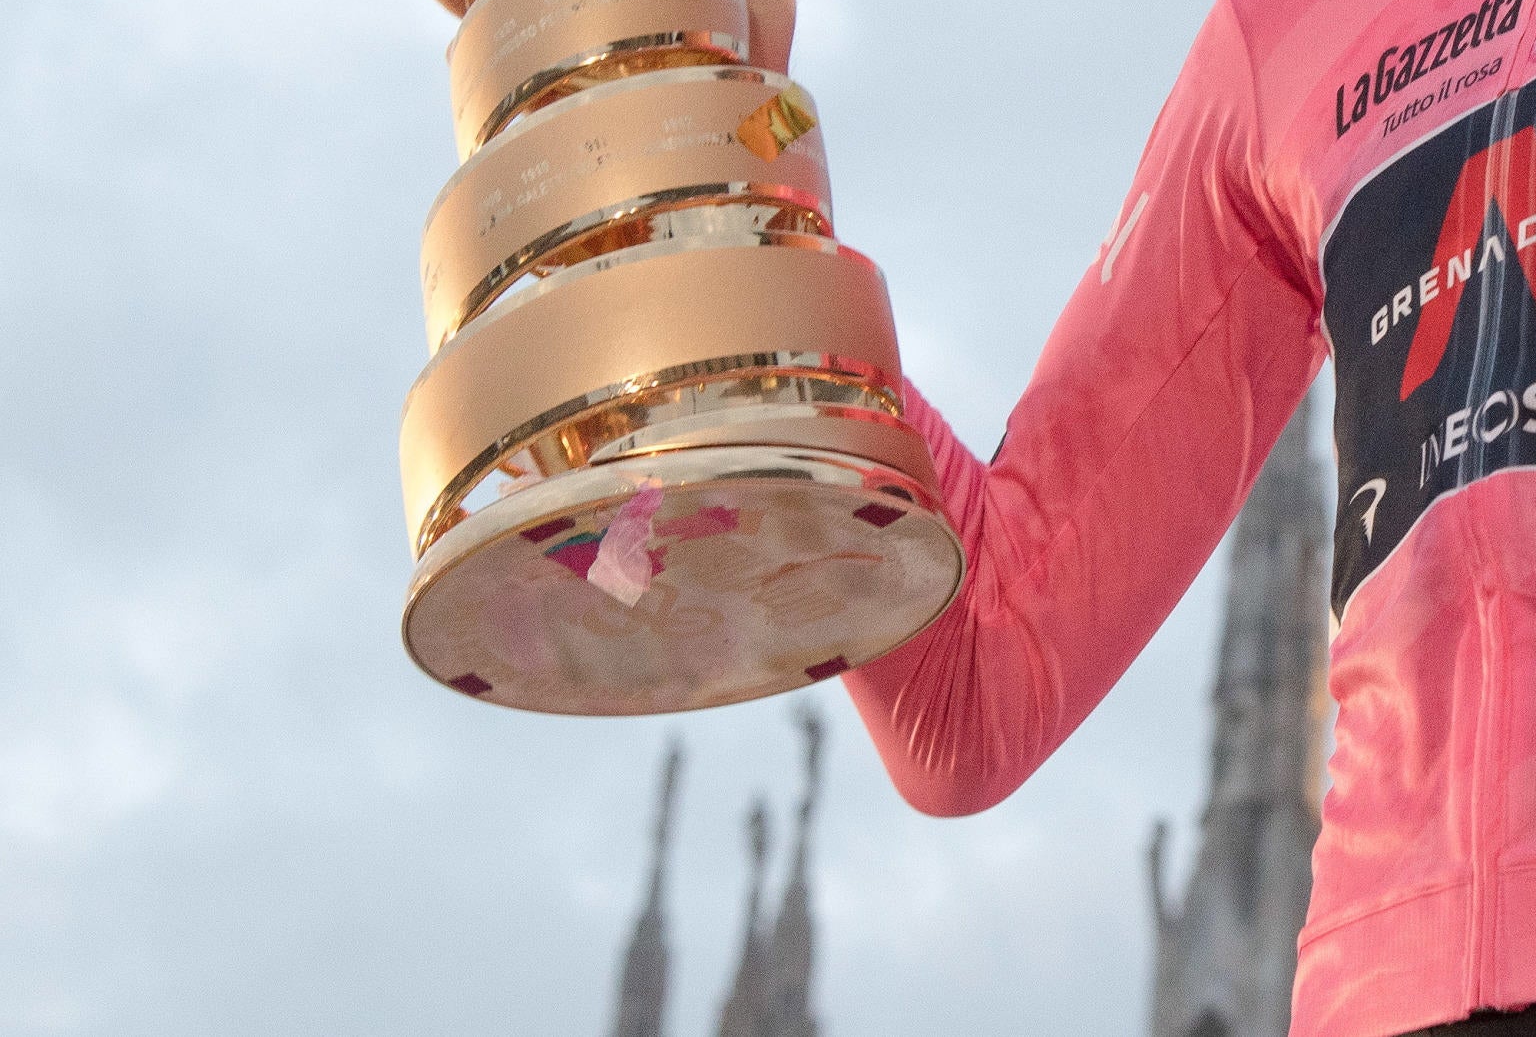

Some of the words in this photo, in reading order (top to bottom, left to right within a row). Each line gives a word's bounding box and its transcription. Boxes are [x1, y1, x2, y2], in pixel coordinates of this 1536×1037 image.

[1382, 93, 1435, 138] Tutto
[1437, 75, 1453, 105] il
[1454, 56, 1503, 94] rosa
